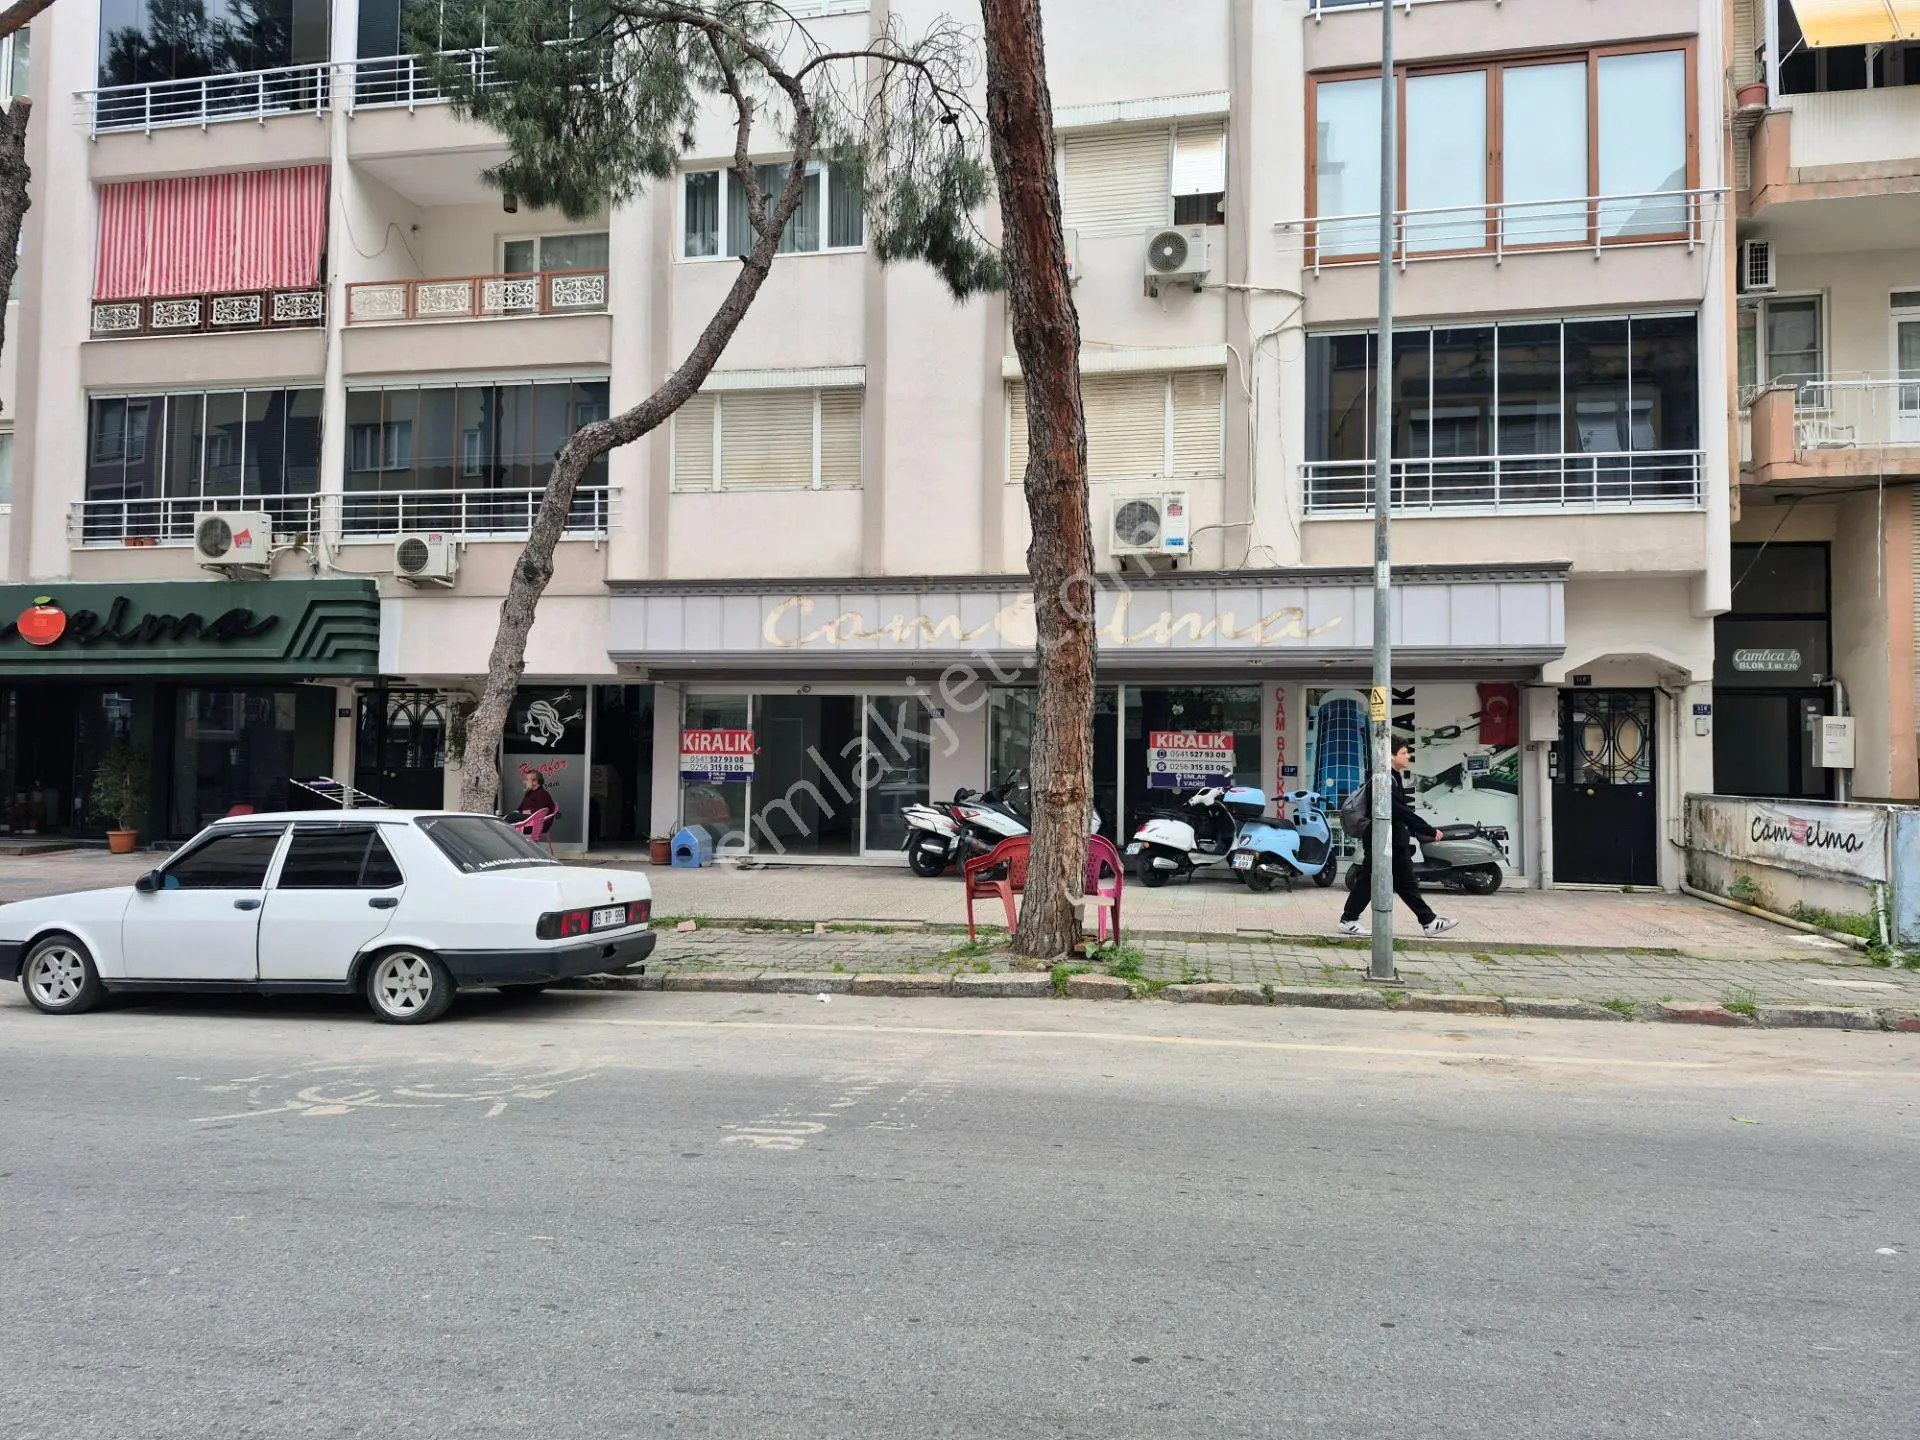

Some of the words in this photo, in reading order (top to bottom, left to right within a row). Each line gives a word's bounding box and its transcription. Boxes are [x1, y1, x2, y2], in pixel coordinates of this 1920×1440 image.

[71, 595, 280, 645] elma
[763, 594, 992, 647] Cam
[1275, 687, 1286, 731] CAM
[1190, 763, 1203, 771] 315
